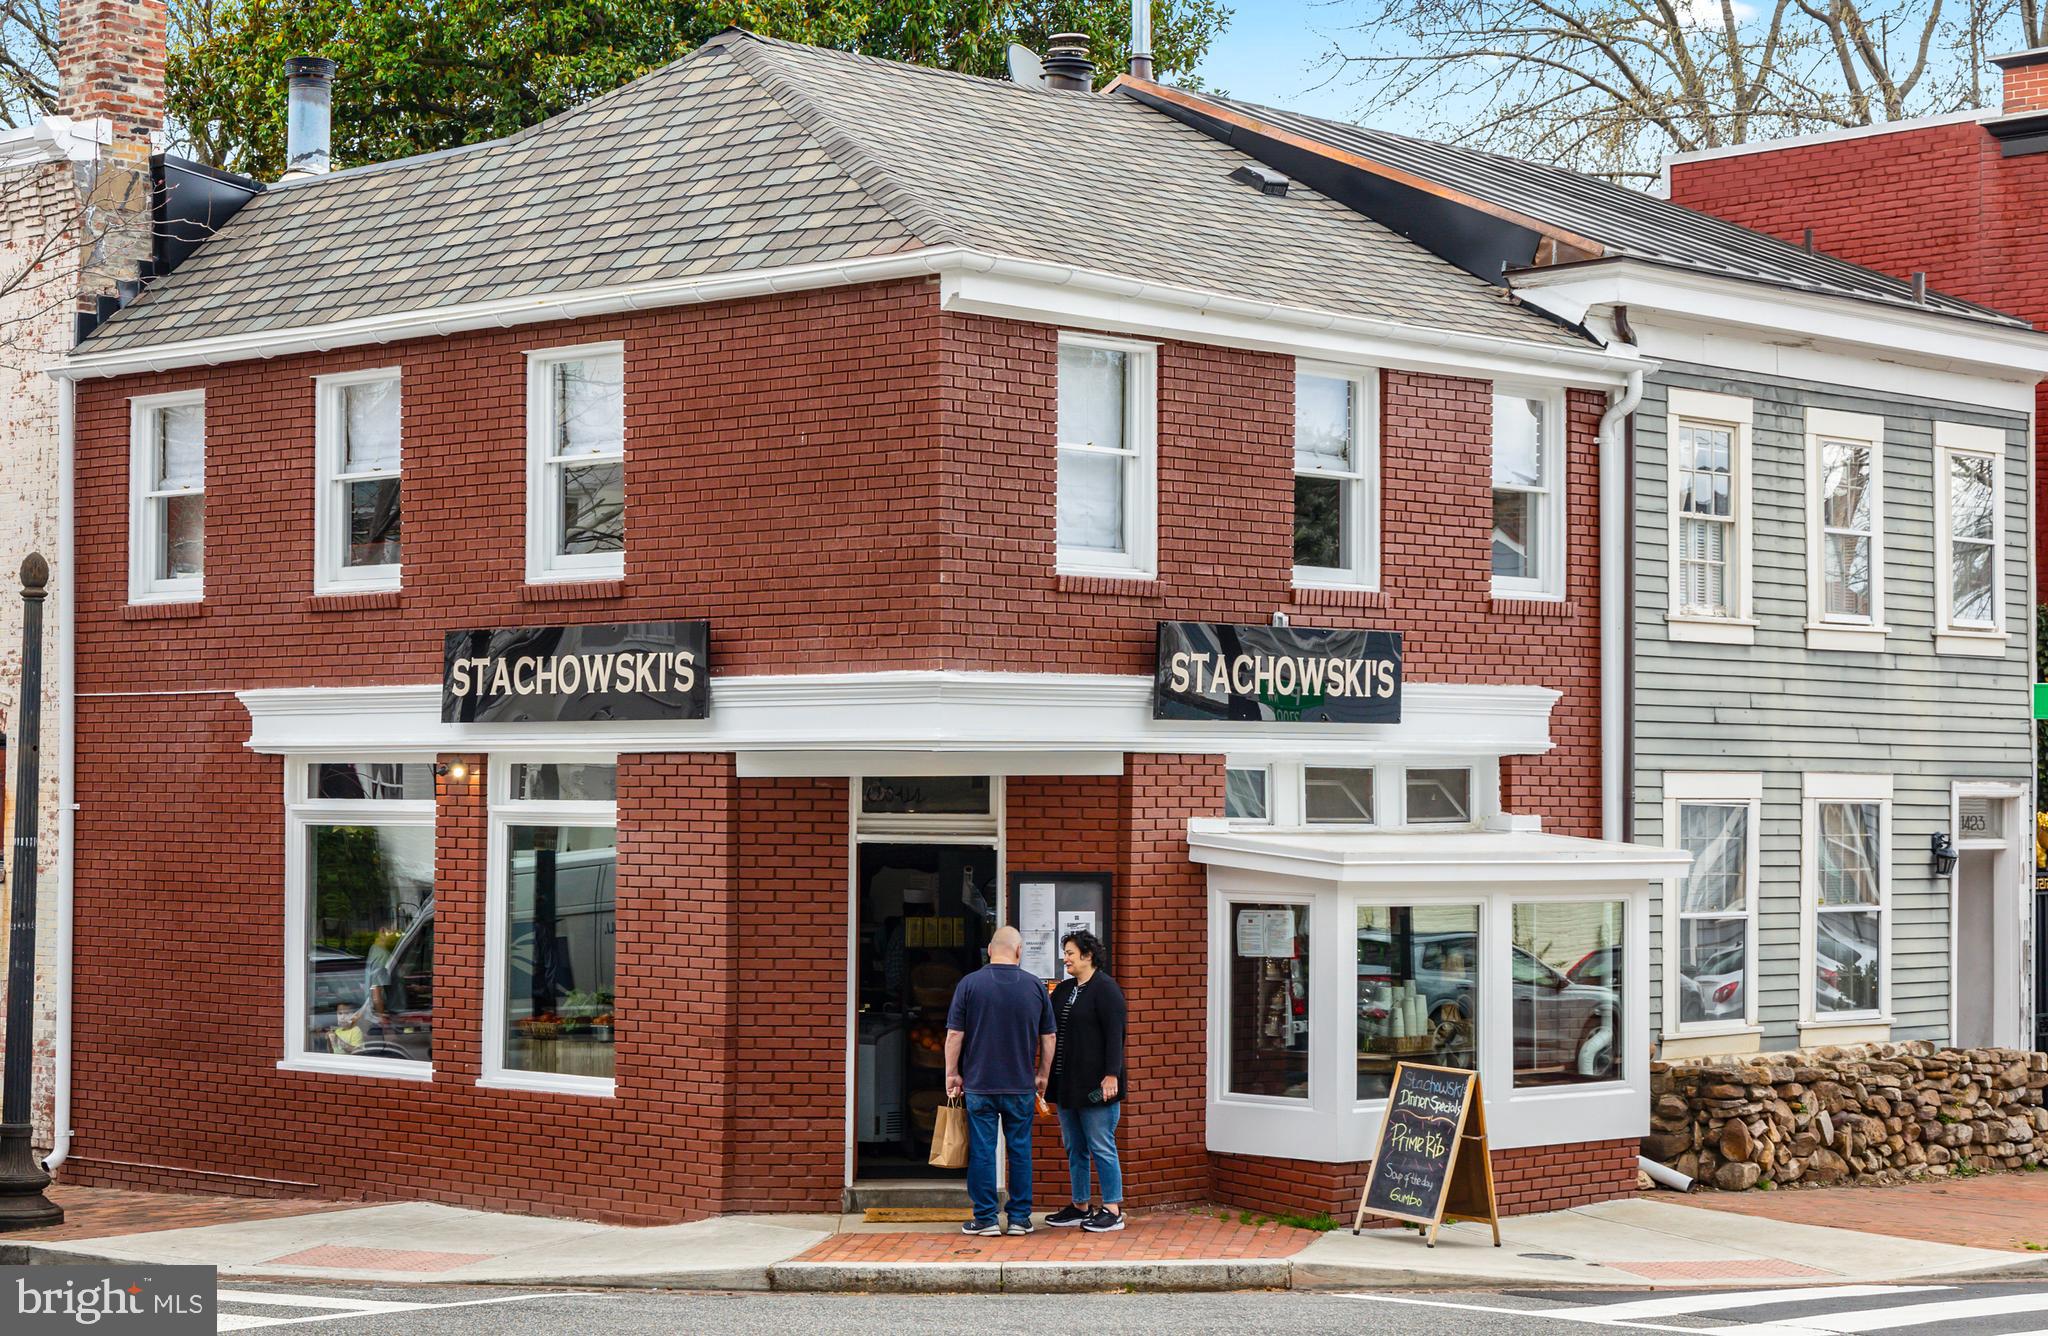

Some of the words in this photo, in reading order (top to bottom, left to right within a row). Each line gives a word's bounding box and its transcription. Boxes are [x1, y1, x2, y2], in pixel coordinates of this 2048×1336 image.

[452, 651, 696, 697] STACHOWSKI'S
[1170, 651, 1395, 698] STACHOWSKI'S
[1961, 815, 1985, 831] 1423
[1398, 1089, 1430, 1110] Dinner
[1429, 1096, 1462, 1117] Specials
[1391, 1122, 1424, 1153] Prime
[1425, 1131, 1445, 1159] Rib
[1384, 1162, 1404, 1184] Soup
[1404, 1172, 1412, 1188] of
[1410, 1172, 1422, 1186] the
[1421, 1174, 1434, 1192] day
[1390, 1187, 1423, 1207] Gumbo
